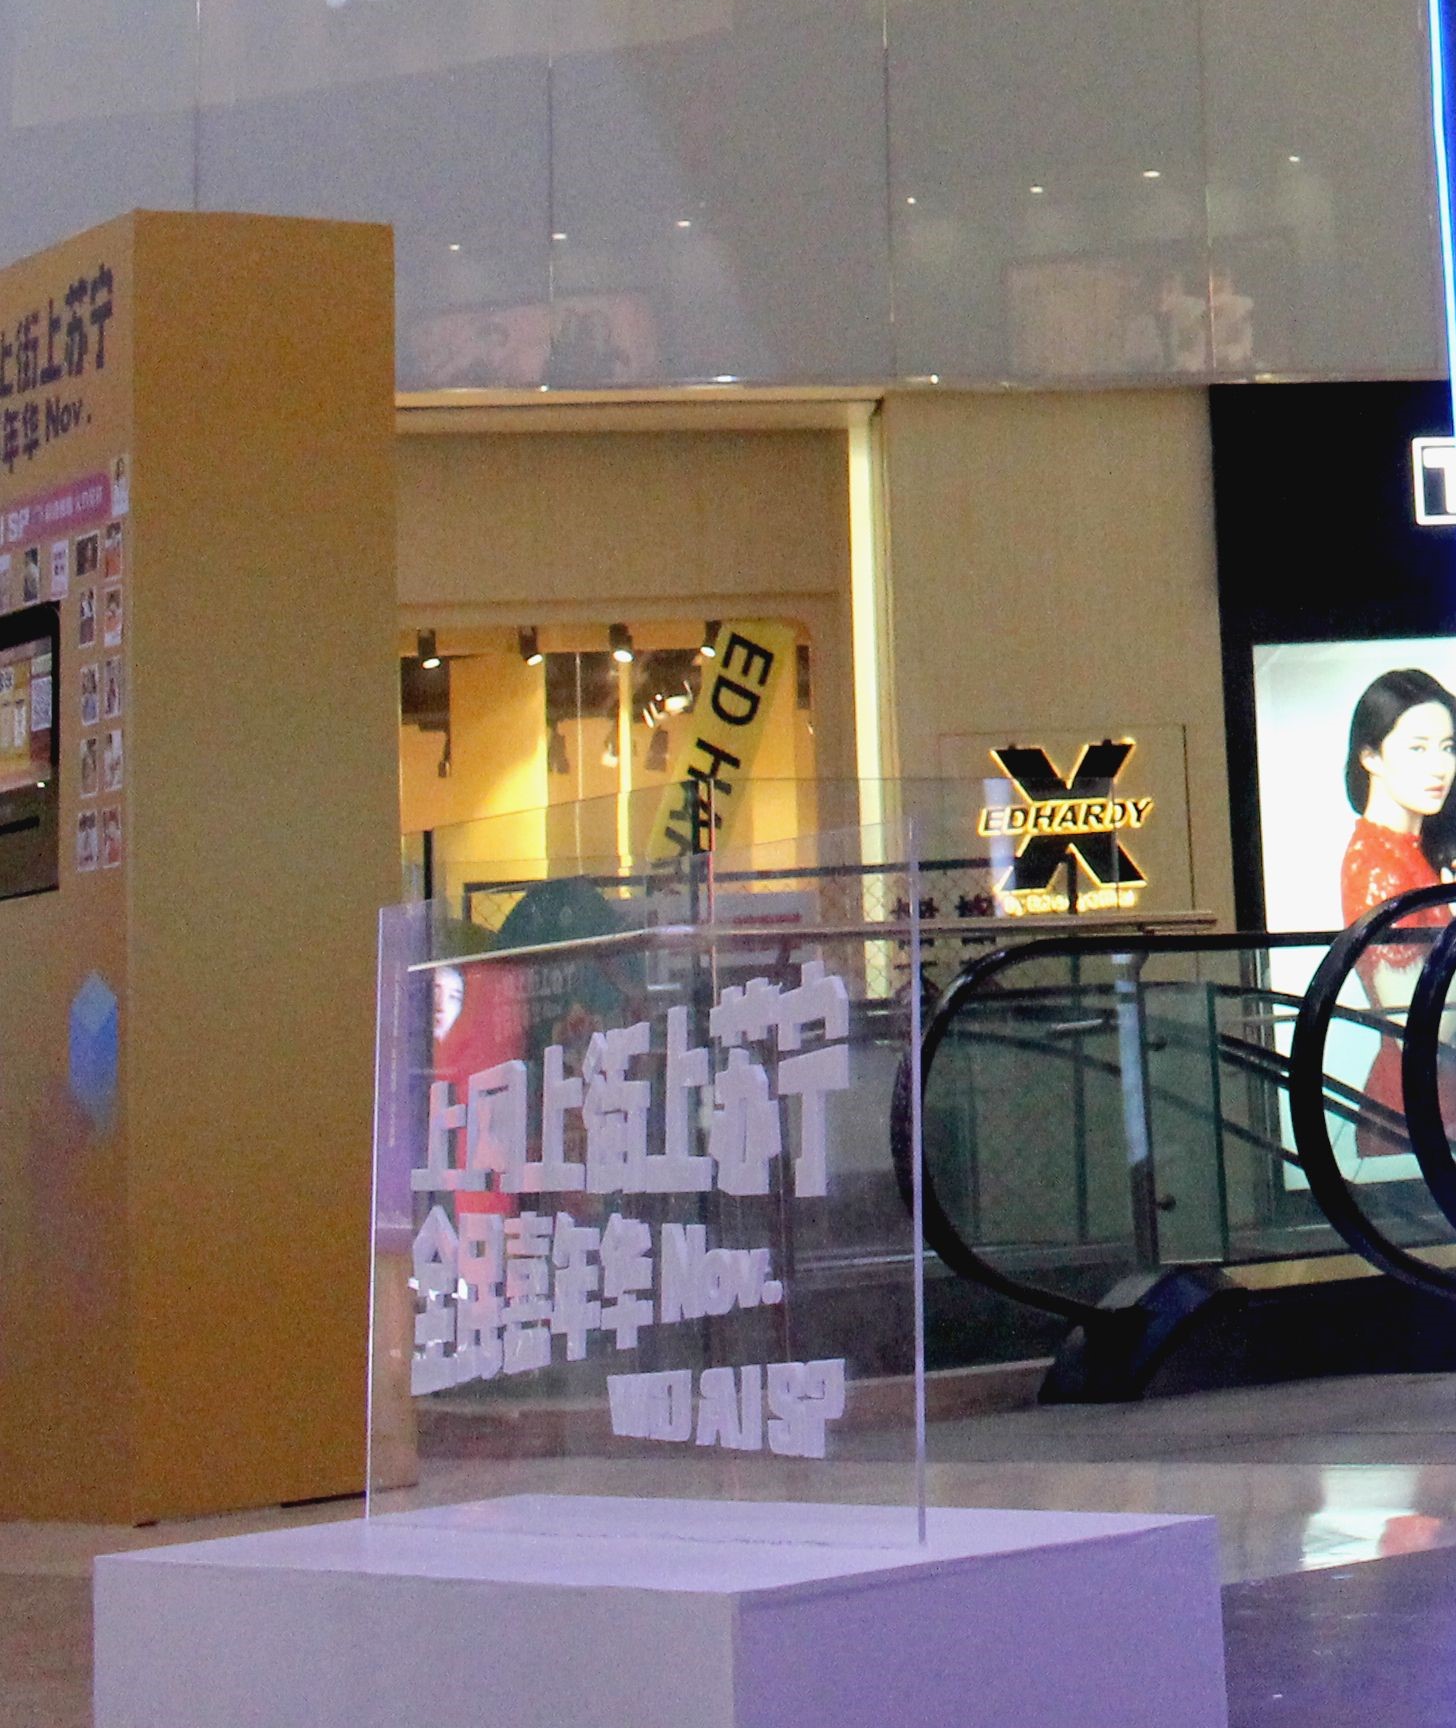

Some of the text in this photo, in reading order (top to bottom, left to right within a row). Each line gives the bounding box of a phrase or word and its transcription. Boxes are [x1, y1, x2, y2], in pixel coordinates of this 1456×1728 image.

[44, 396, 92, 443] Nov.
[711, 631, 775, 726] ED
[977, 796, 1155, 837] EDHARDY
[660, 1222, 785, 1324] Nov.
[766, 1357, 847, 1460] SP
